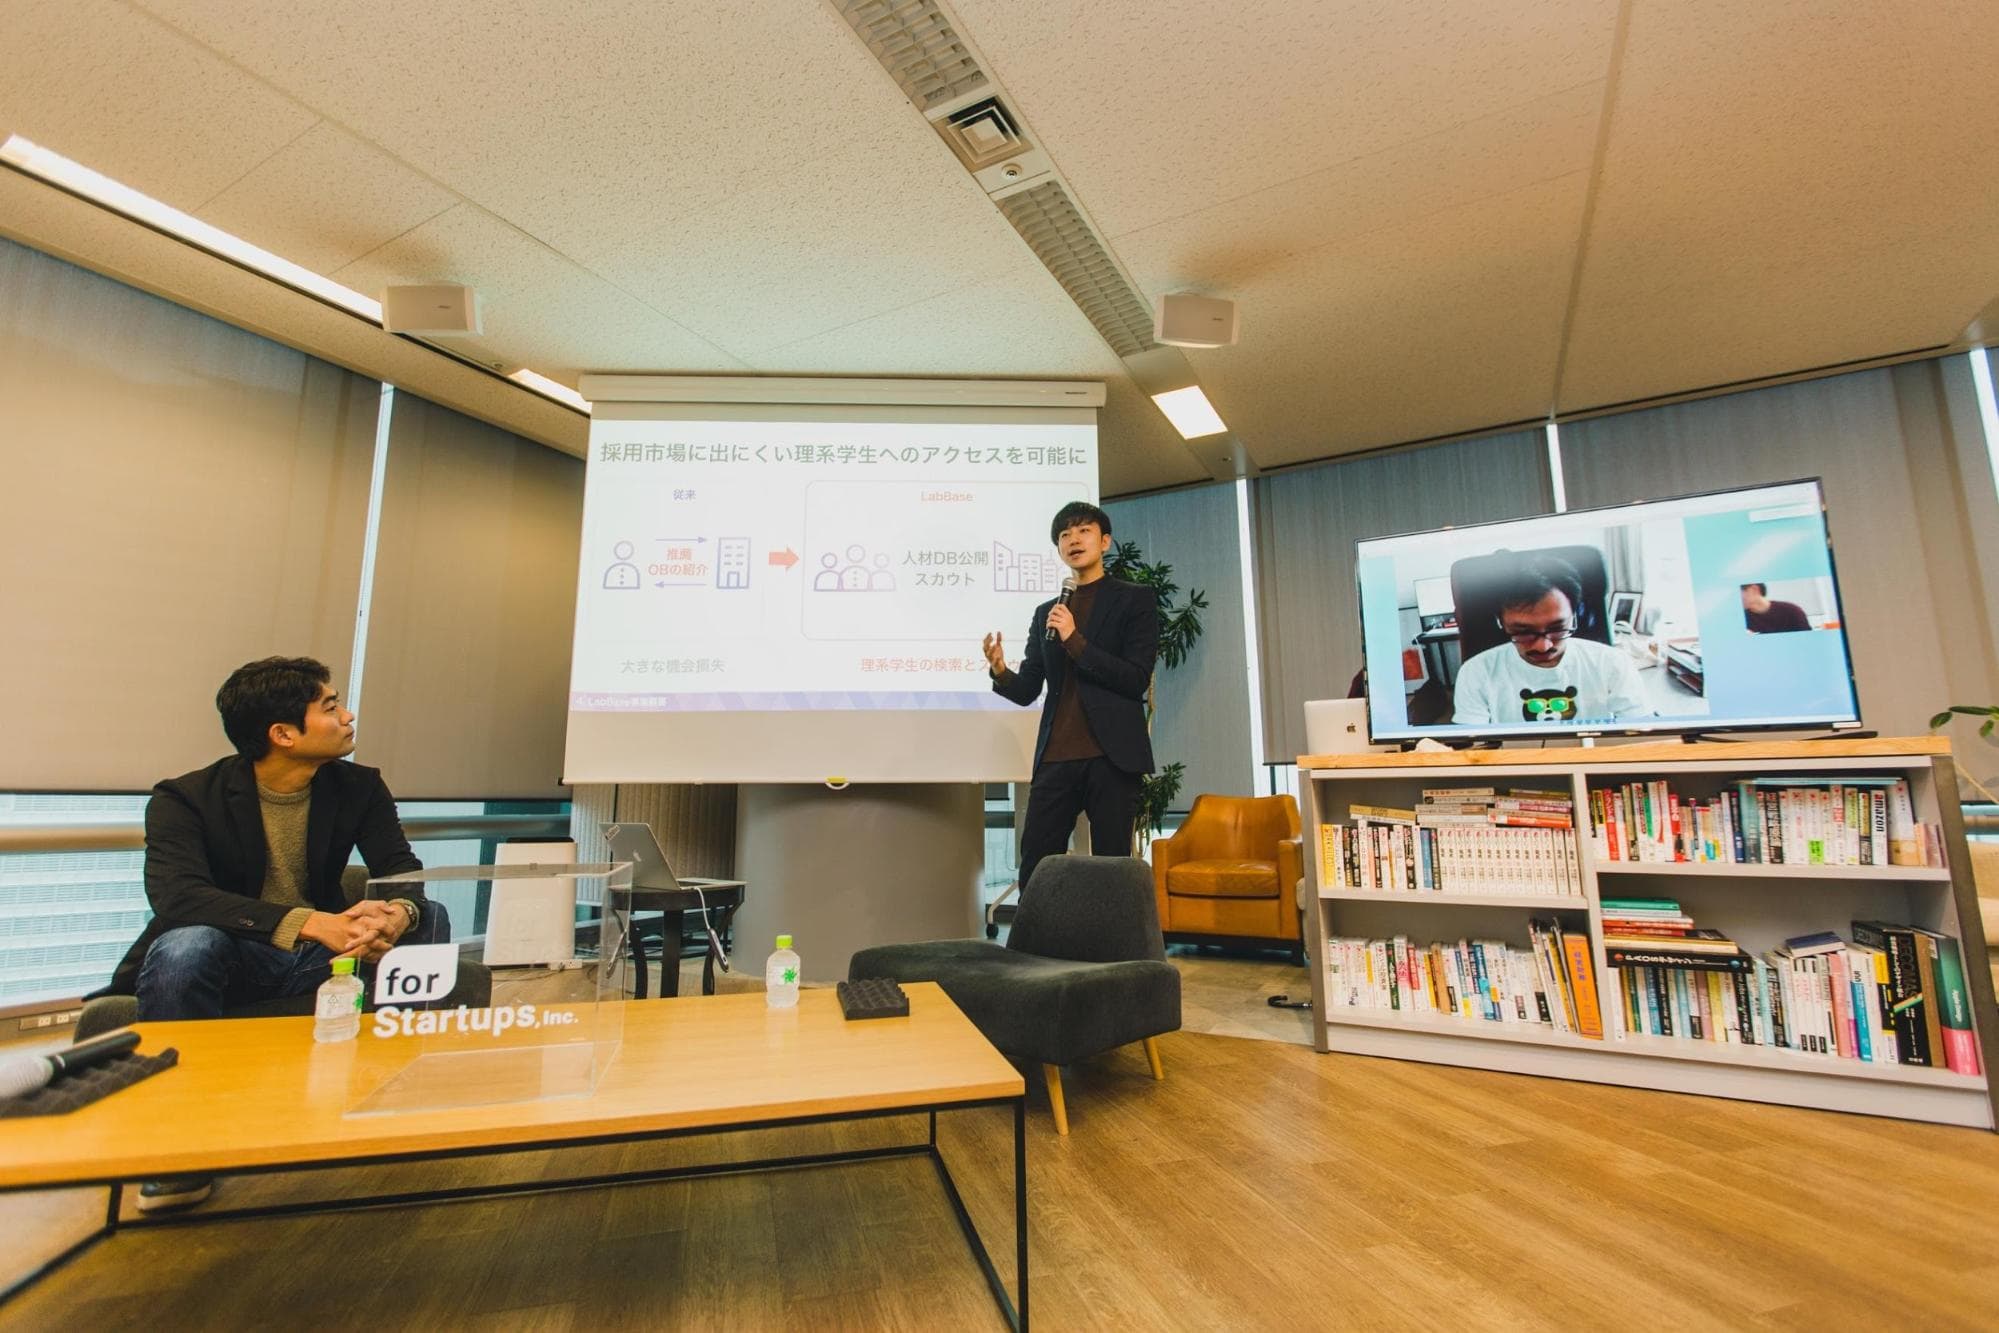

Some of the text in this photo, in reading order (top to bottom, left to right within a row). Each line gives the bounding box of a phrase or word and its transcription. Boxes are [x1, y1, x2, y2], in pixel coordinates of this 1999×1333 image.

[600, 442, 1087, 466] 採用市場に出にくい理系学生へのアクセスを可能に
[672, 488, 697, 502] 従来
[920, 490, 974, 503] LabBase
[666, 547, 693, 562] 推薦
[902, 549, 989, 567] 人材DB公開
[648, 562, 709, 577] OBの紹介
[914, 571, 976, 588] スカウト
[620, 658, 725, 674] 大きな機会損失
[1873, 794, 1885, 832] amazon
[386, 967, 440, 997] for
[374, 1004, 579, 1038] Startups, Inc.
